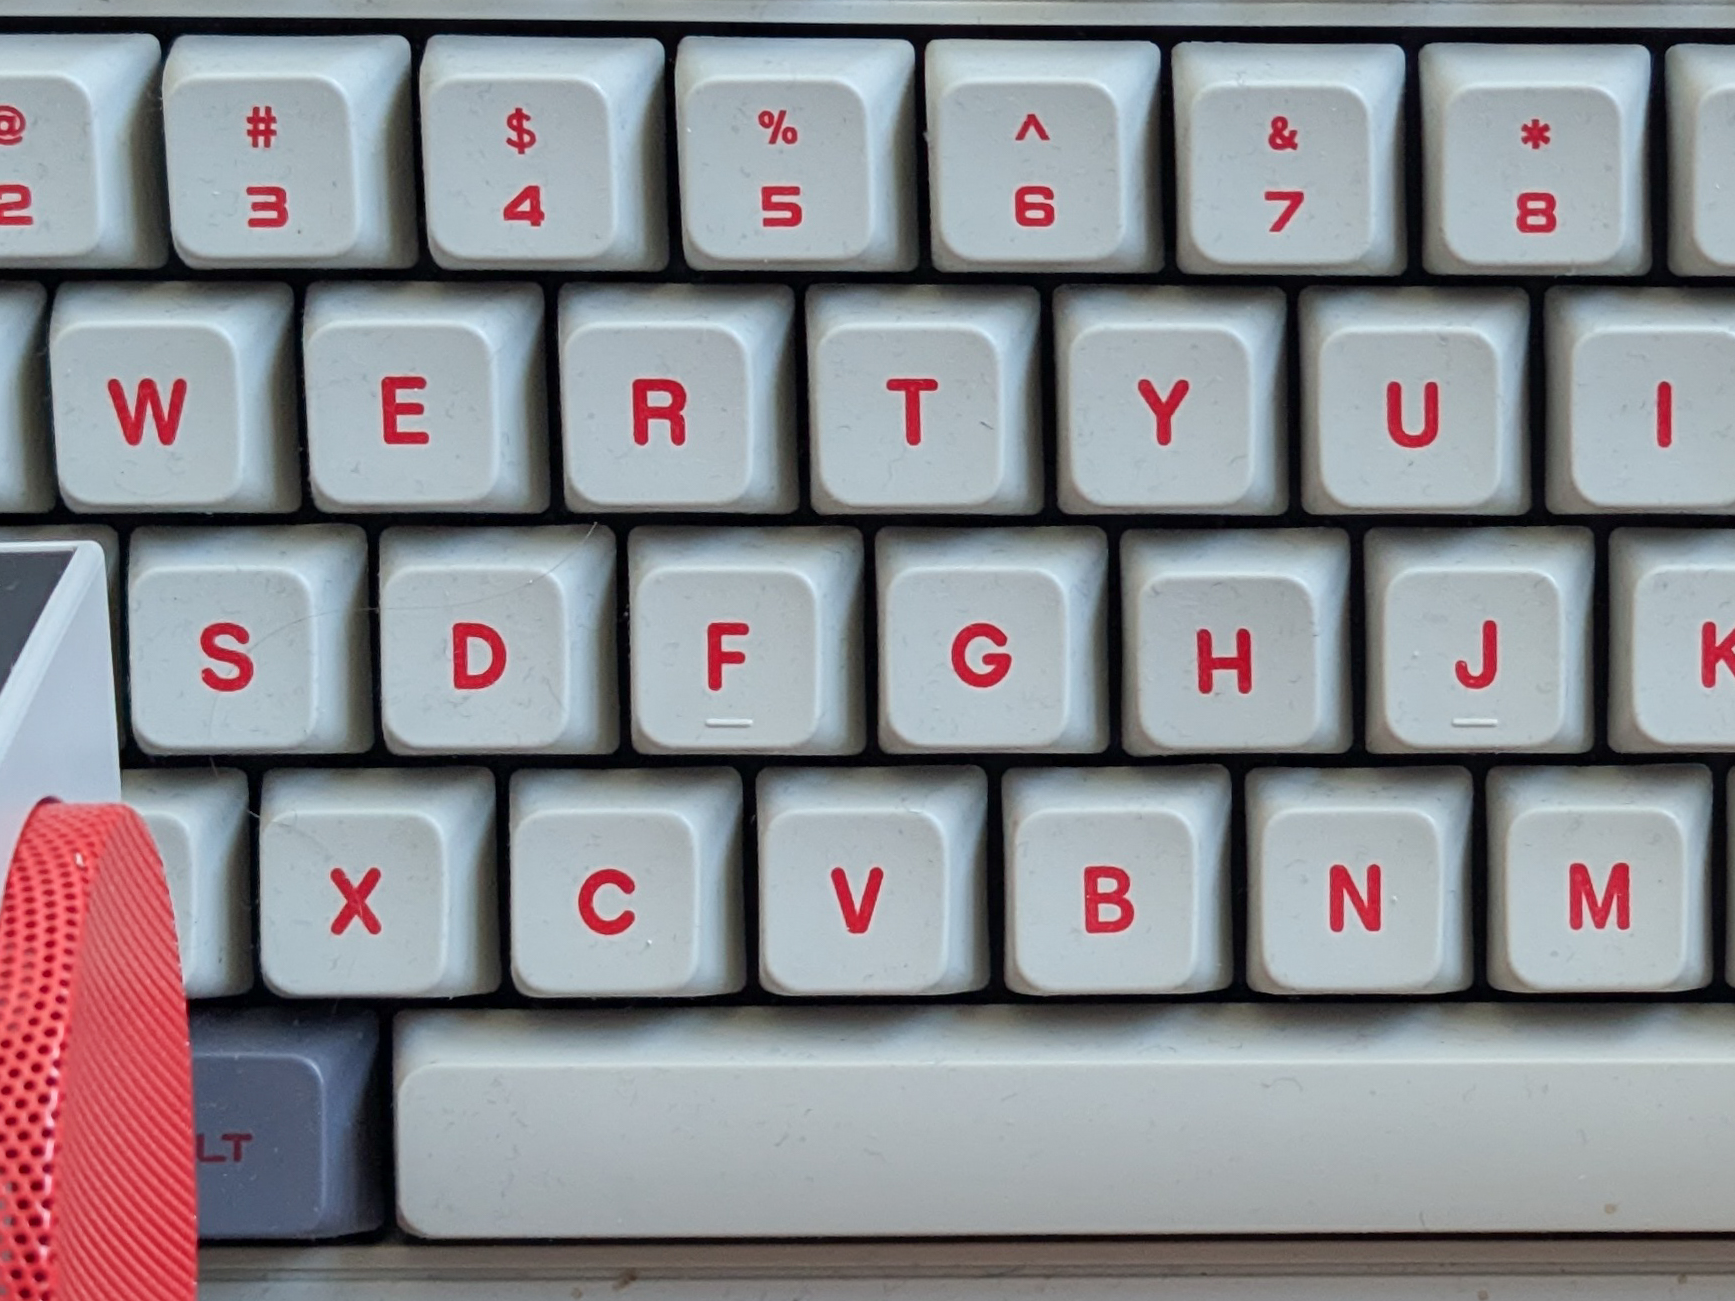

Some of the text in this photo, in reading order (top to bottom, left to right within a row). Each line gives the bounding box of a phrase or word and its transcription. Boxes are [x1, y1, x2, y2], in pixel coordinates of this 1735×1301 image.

[246, 107, 276, 148] #
[506, 107, 536, 154] $
[758, 110, 798, 145] %
[1016, 114, 1049, 140] ^
[1268, 116, 1298, 150] &
[247, 186, 288, 227] 3
[503, 185, 545, 227] 4
[761, 186, 803, 228] 5
[1015, 186, 1055, 227] 6
[1265, 190, 1304, 232] 7
[1516, 192, 1557, 234] 8
[107, 378, 187, 446] W
[381, 376, 429, 445] E
[632, 378, 687, 446] R
[886, 378, 938, 446] T
[1138, 379, 1190, 445] Y
[1387, 381, 1439, 449] U
[1657, 381, 1673, 448] I
[199, 623, 253, 692] S
[452, 622, 507, 689] D
[707, 622, 749, 691] F
[951, 623, 1012, 688] G
[1197, 628, 1253, 694] H
[1455, 620, 1498, 690] J
[331, 868, 381, 935] X
[578, 868, 635, 936] C
[831, 867, 883, 934] V
[1083, 866, 1135, 934] B
[1329, 864, 1381, 932] N
[1569, 863, 1631, 930] M
[195, 1133, 254, 1163] LT
